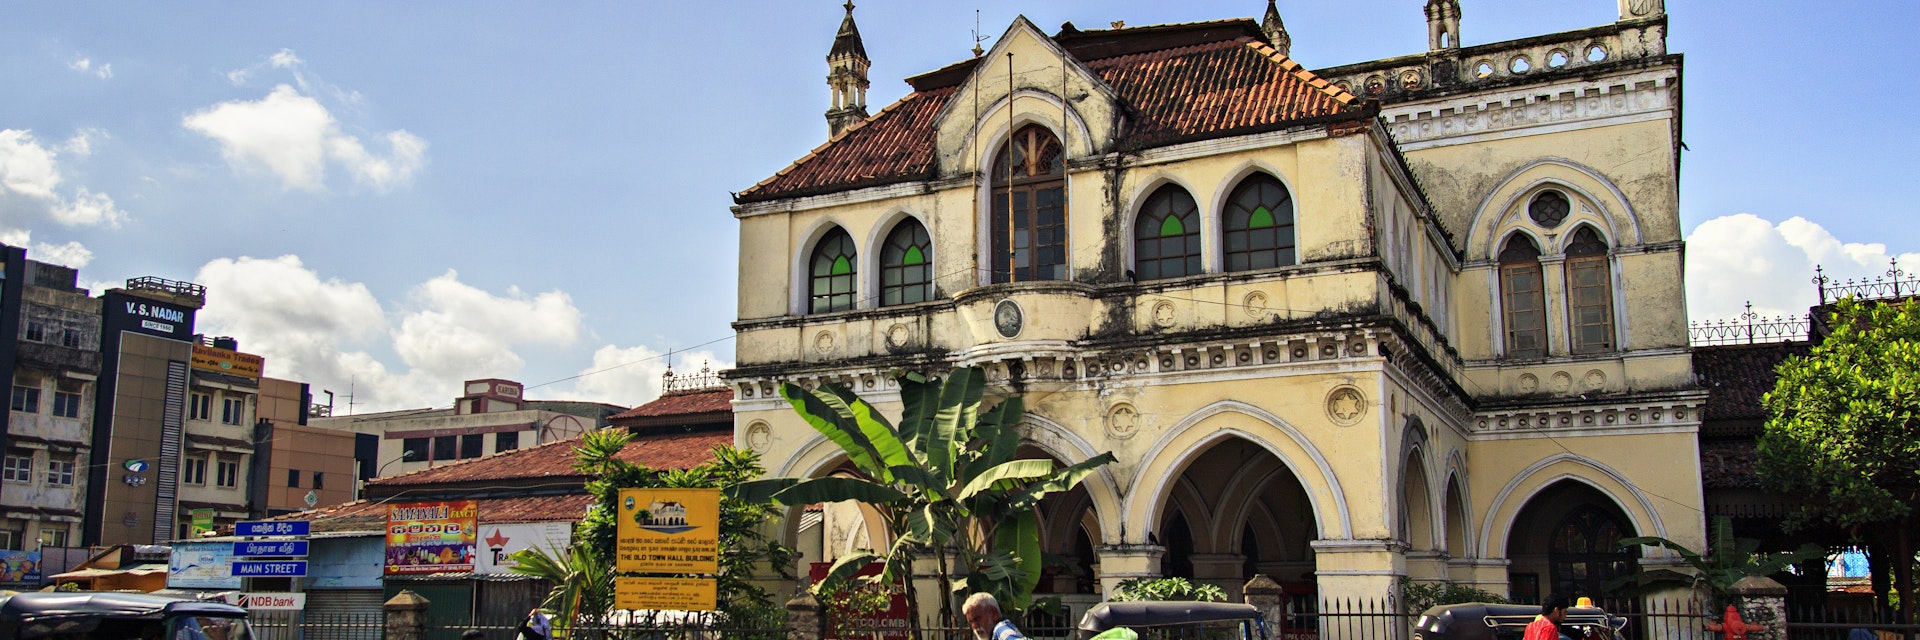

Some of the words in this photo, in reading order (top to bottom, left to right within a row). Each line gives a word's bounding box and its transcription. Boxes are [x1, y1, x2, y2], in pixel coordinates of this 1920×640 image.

[126, 301, 136, 314] V.
[138, 304, 149, 316] S.
[151, 306, 184, 323] NADAR
[391, 506, 449, 521] SAMANALA
[450, 509, 475, 518] FANCY
[240, 564, 263, 574] MAIN
[264, 563, 298, 574] STREET
[251, 596, 272, 607] NDB
[273, 596, 296, 607] bank
